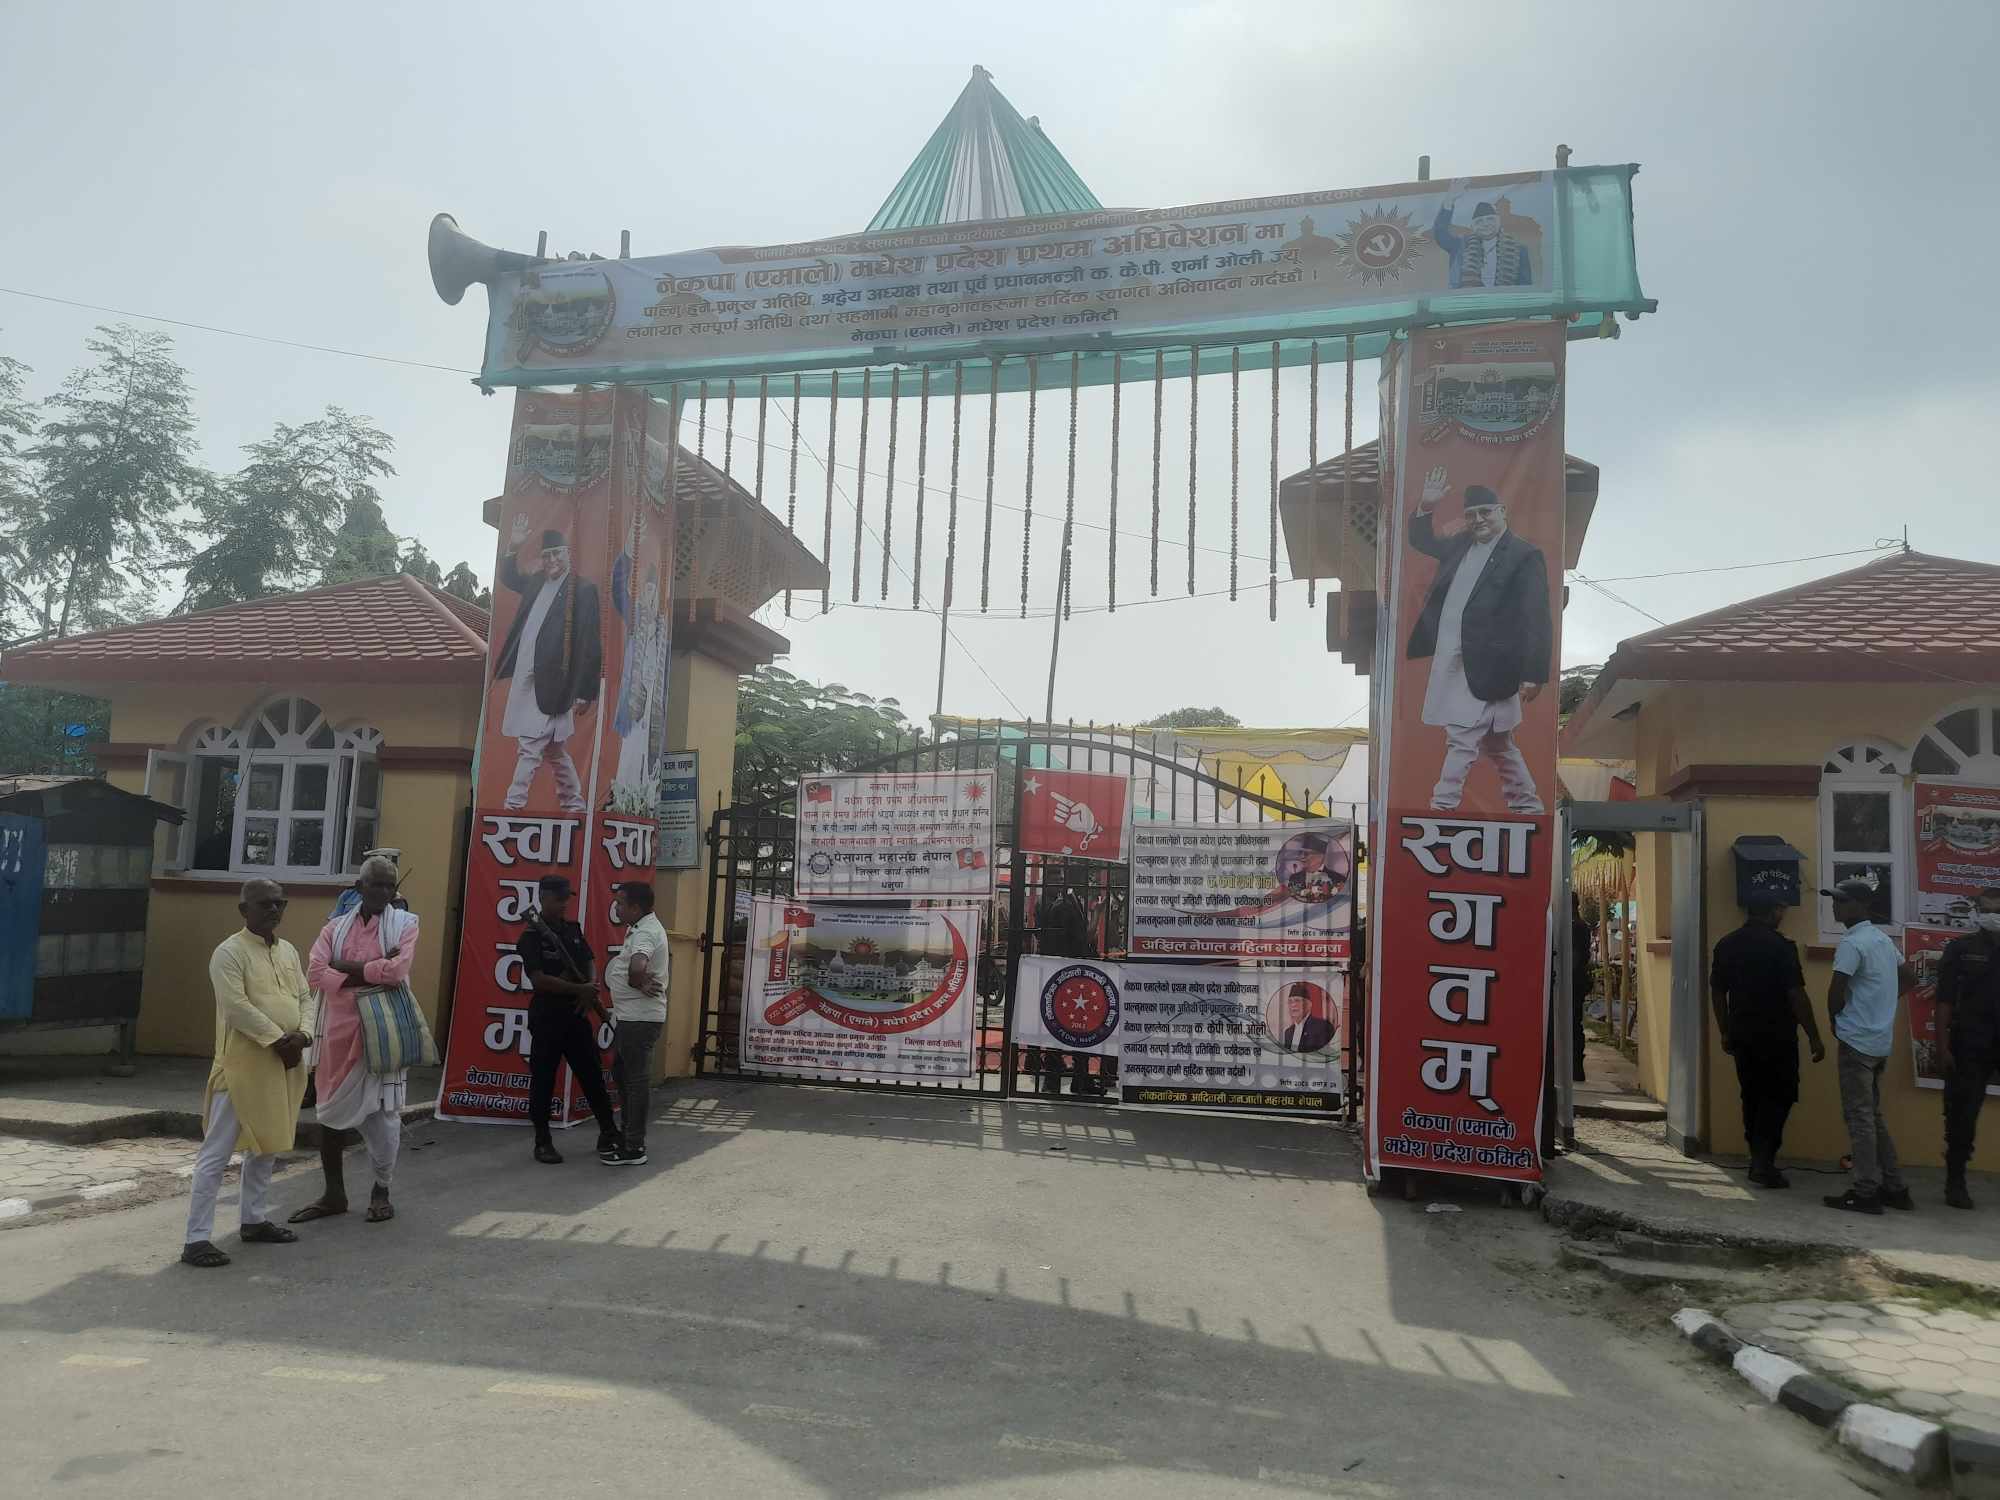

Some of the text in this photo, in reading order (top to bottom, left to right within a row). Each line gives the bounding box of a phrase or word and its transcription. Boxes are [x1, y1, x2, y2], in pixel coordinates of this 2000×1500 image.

[654, 222, 1287, 296] नेकपा (एमाले) मधेश प्रदेश प्रथम अधिवेशन मा
[867, 284, 922, 301] अध्यक्ष
[926, 279, 959, 296] तथा
[965, 273, 987, 295] पूर्व
[993, 265, 1084, 290] प्रधानमन्त्री
[1170, 254, 1209, 275] शर्मा
[1215, 249, 1265, 269] ओली
[1270, 246, 1304, 267] ज्यू
[625, 323, 682, 340] लगायत
[687, 317, 739, 336] सम्पूर्ण
[743, 313, 793, 332] अतिथि
[799, 311, 829, 329] तथा
[837, 304, 899, 325] सहभागी
[1033, 289, 1089, 308] हार्दिक
[1096, 283, 1153, 301] स्वागत
[1158, 275, 1244, 297] अभिवादन
[850, 327, 898, 343] नेकपा
[967, 318, 1010, 334] मधेश
[1015, 314, 1056, 332] प्रदेश
[1062, 306, 1121, 326] कमिटी
[922, 850, 952, 863] नेपाल
[1142, 938, 1342, 957] अखिल नेपाल महिला धनुषा
[1245, 1021, 1267, 1036] ओली
[466, 1066, 507, 1087] नेकपा
[448, 1089, 485, 1107] मधेश
[486, 1092, 518, 1113] प्रदेश
[1298, 1095, 1323, 1107] नेपाल
[1401, 1107, 1517, 1141] नेकपा (एमाले)
[1384, 1135, 1535, 1169] मधेश प्रदेश कमिटी
